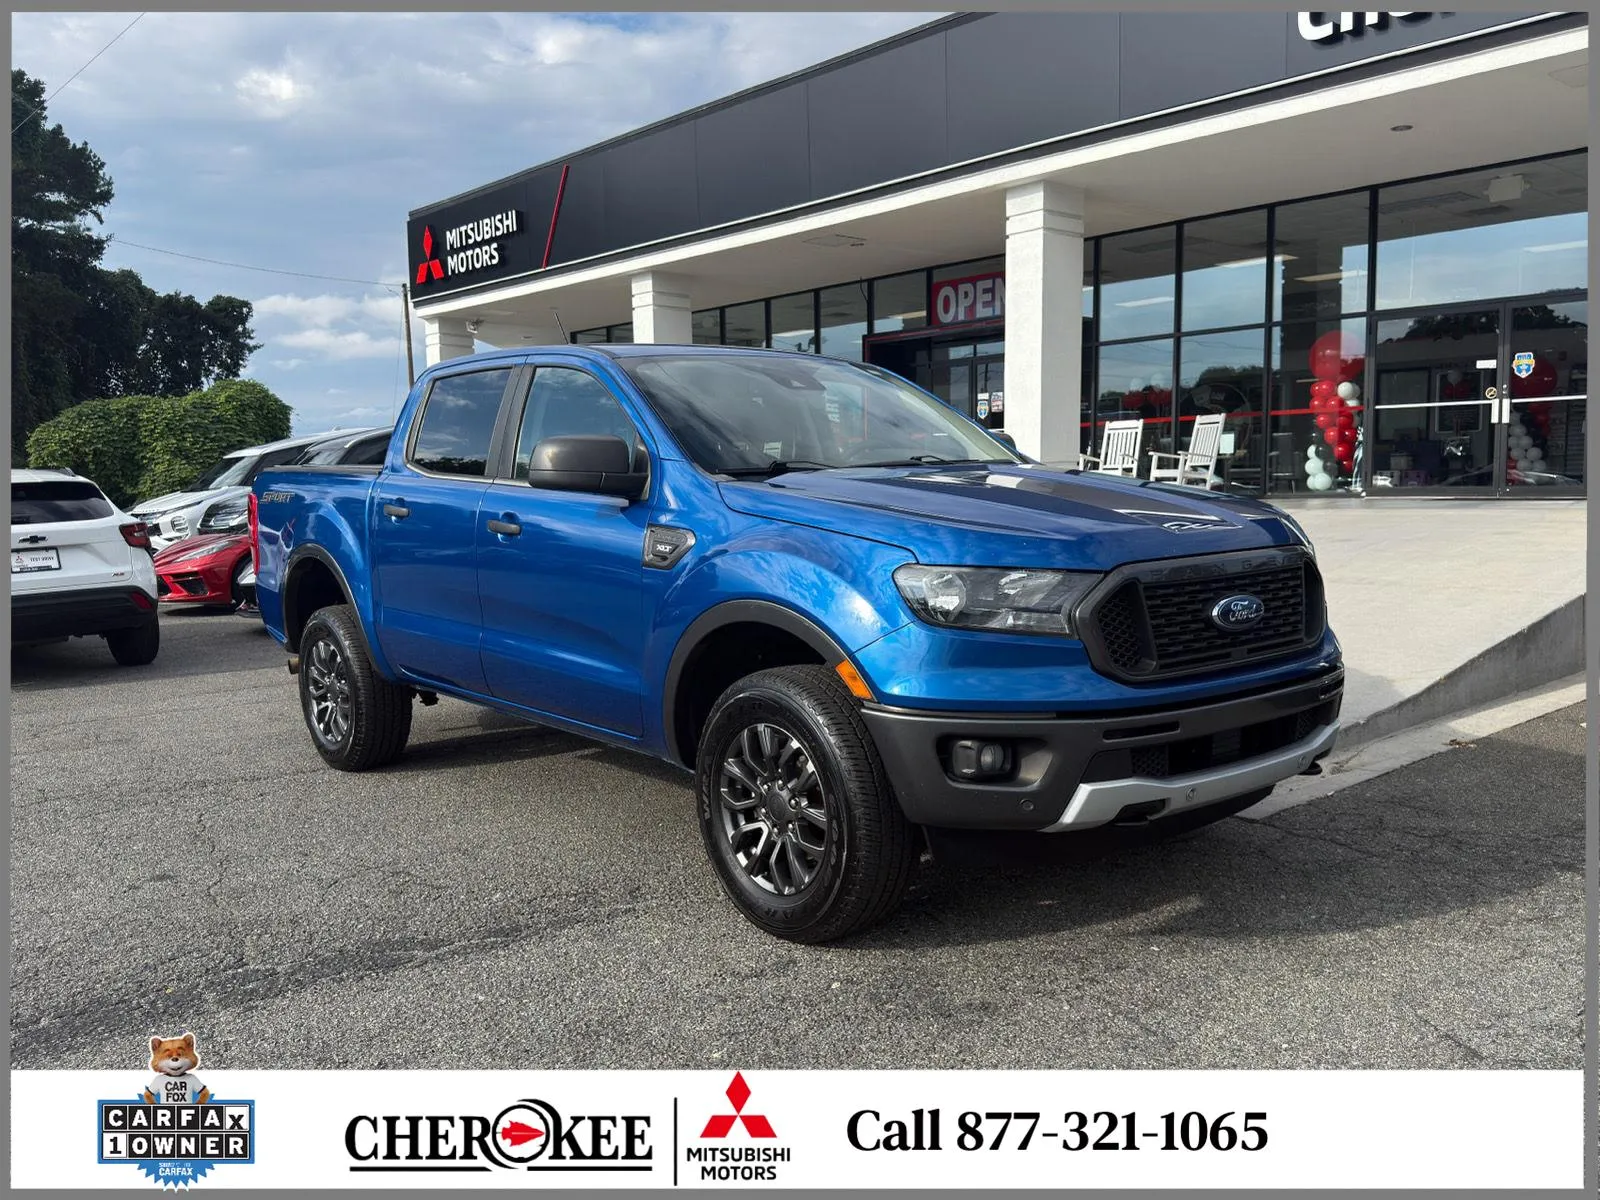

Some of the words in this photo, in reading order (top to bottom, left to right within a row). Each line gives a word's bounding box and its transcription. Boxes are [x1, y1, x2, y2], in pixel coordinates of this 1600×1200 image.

[446, 209, 518, 251] MITSUBISHI
[447, 242, 500, 276] MOTORS
[260, 491, 295, 503] SPORT
[1229, 600, 1258, 621] Ford
